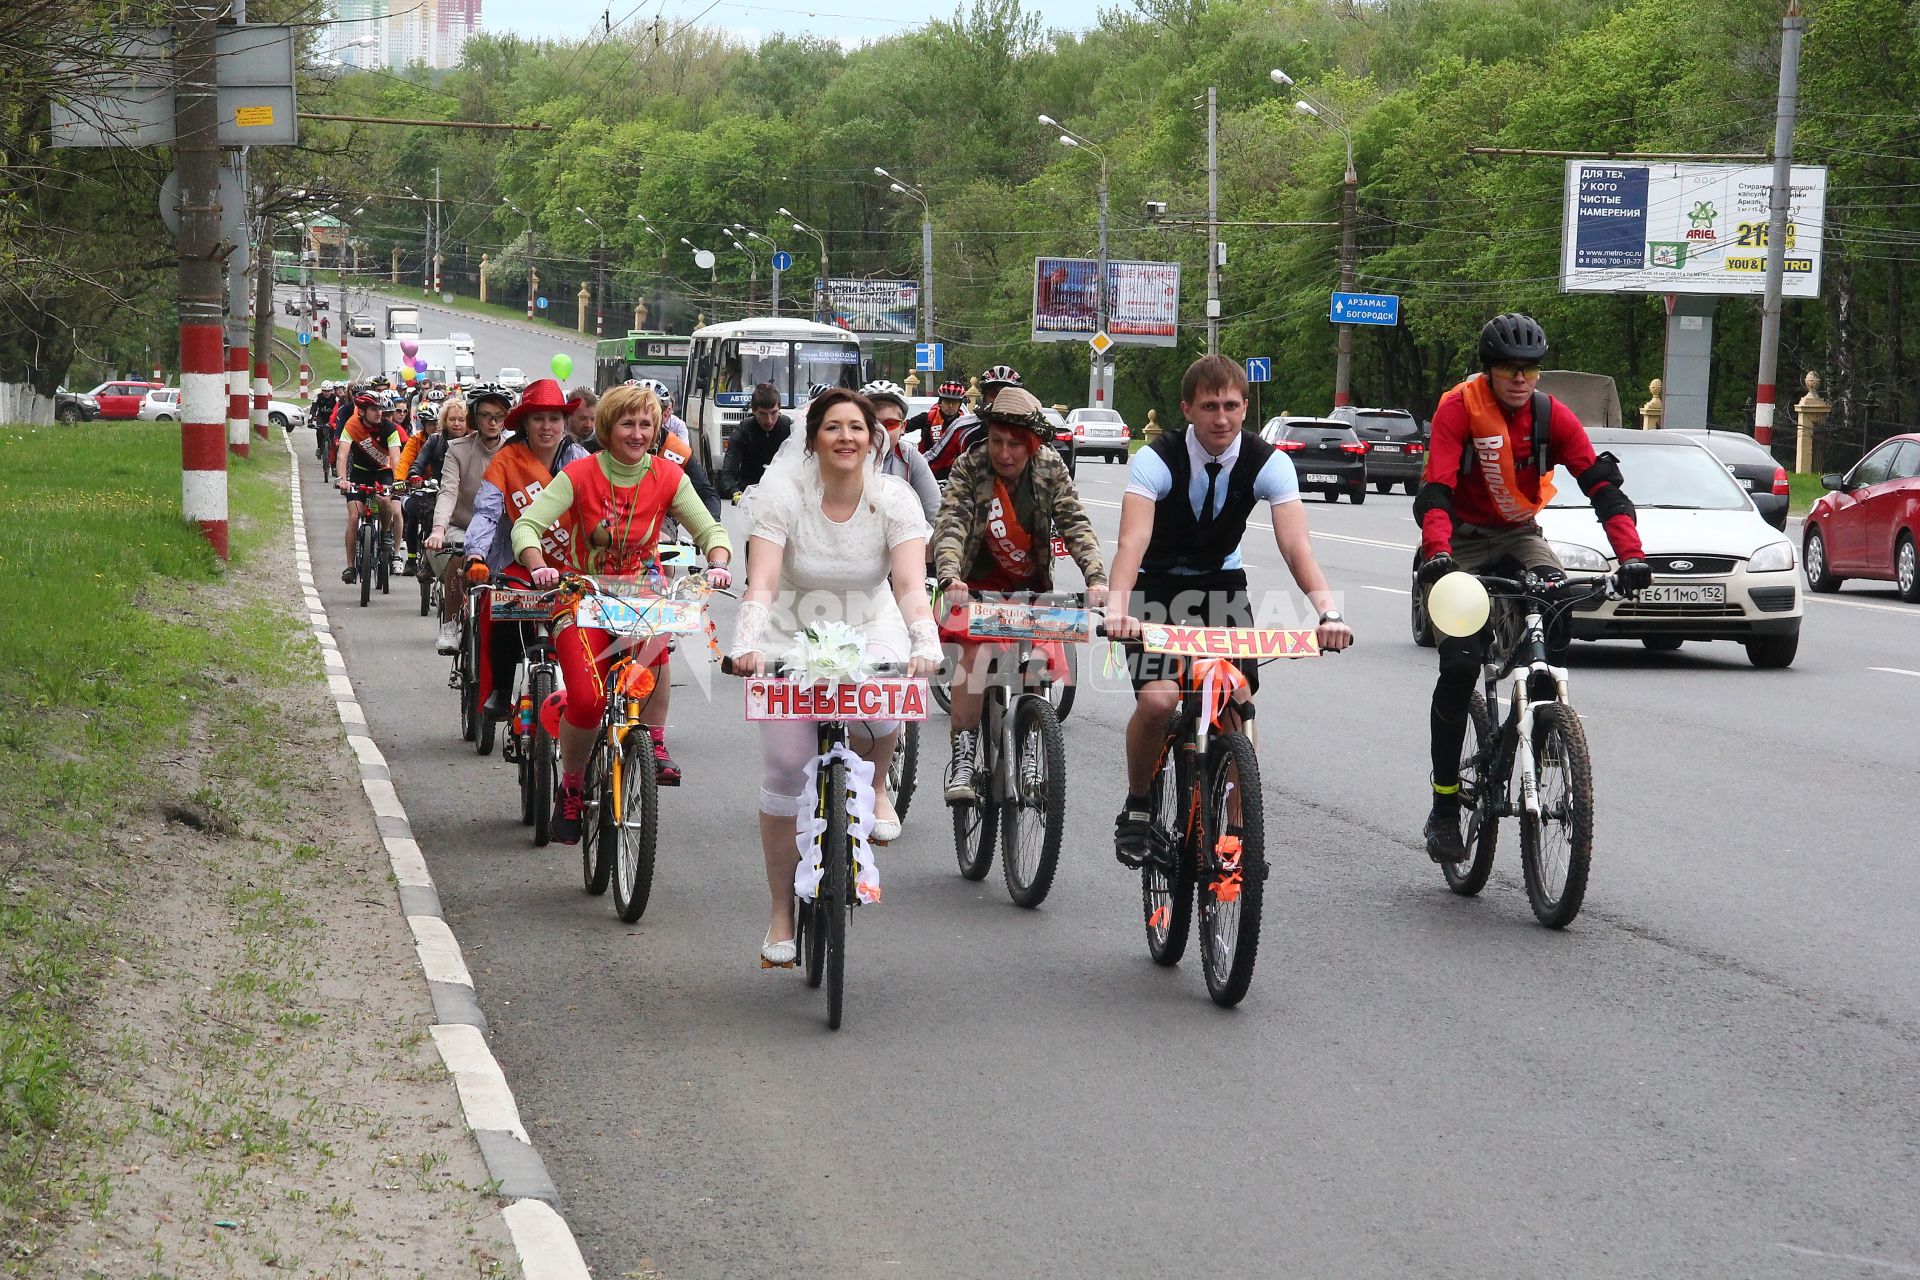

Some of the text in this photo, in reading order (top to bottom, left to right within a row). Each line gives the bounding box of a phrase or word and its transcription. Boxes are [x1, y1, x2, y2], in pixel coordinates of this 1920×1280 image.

[1582, 169, 1626, 180] ДЛЯ ТЕХ,
[1581, 182, 1618, 191] У КОГО
[1580, 195, 1622, 204] ЧИСТЫЕ
[1579, 207, 1641, 217] НАМЕРЕНИЯ
[1686, 229, 1717, 240] ARIEL
[1591, 257, 1608, 265] (800)
[1728, 259, 1749, 270] YOU
[1750, 259, 1759, 270] &
[1347, 298, 1387, 308] АРЗАМАС
[1346, 310, 1394, 320] БОГОРОДСК
[650, 344, 662, 354] 43
[819, 351, 857, 359] СВОБОДЫ
[1644, 587, 1721, 602] Е611МО 152
[1161, 627, 1317, 655] ЖЕНИХ
[767, 683, 925, 716] НЕВЕСТА
